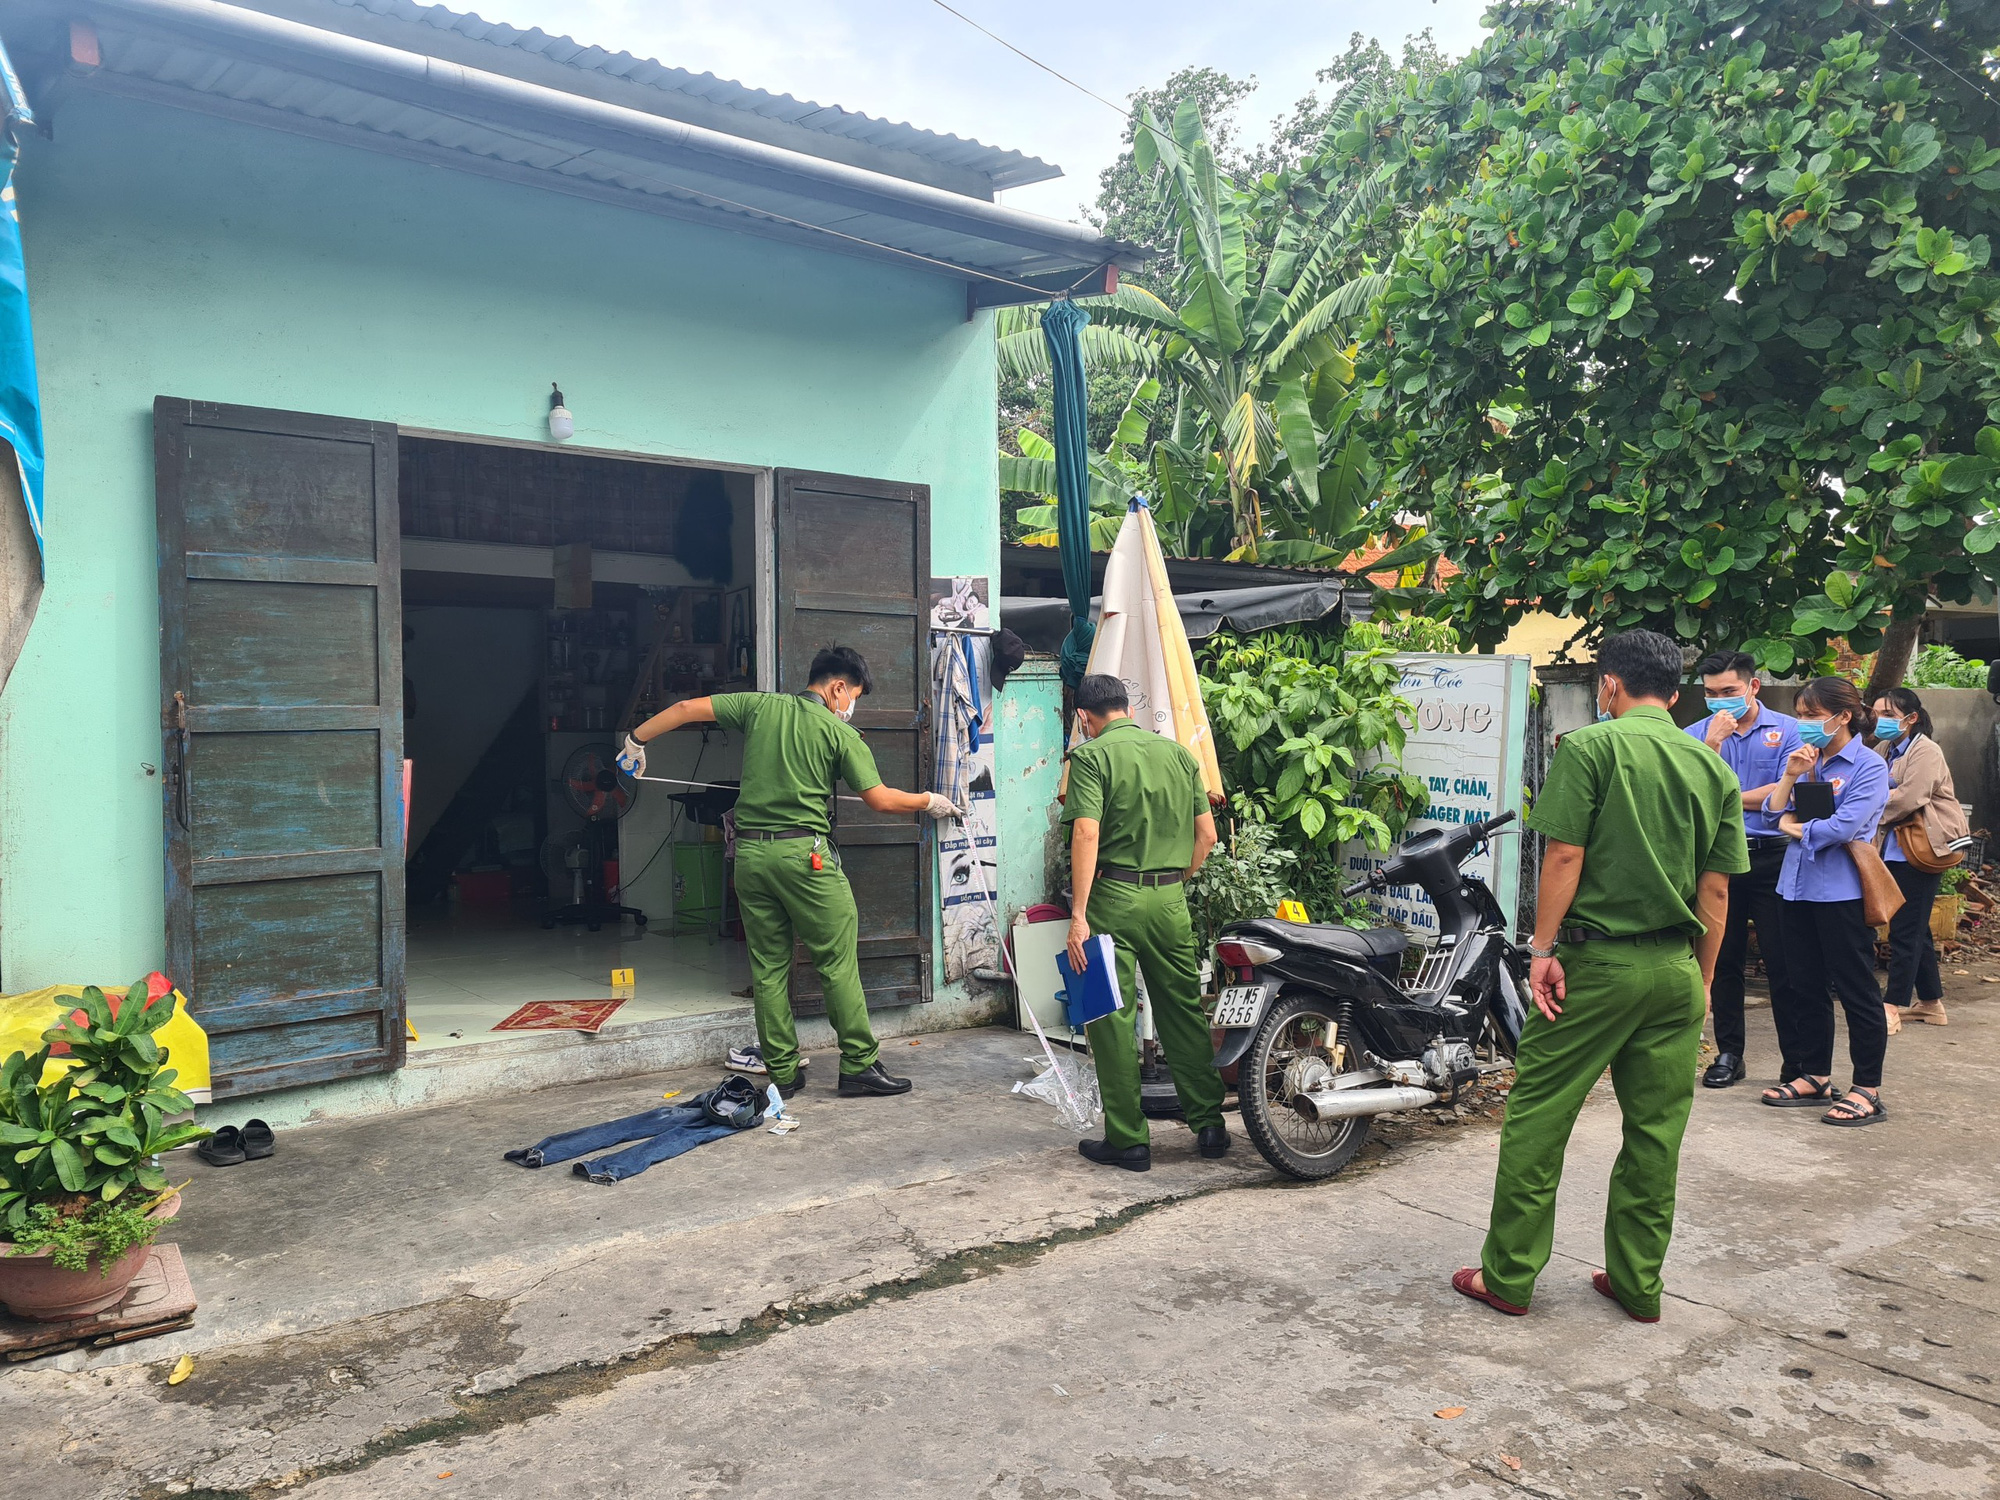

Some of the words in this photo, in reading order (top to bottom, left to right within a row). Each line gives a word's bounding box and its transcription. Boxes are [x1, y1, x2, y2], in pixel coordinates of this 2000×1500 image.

[1392, 696, 1492, 733] ƯƠNG
[1428, 776, 1450, 796] TAY,
[1292, 902, 1301, 917] 4
[619, 970, 626, 983] 1
[1217, 1006, 1253, 1025] 6256
